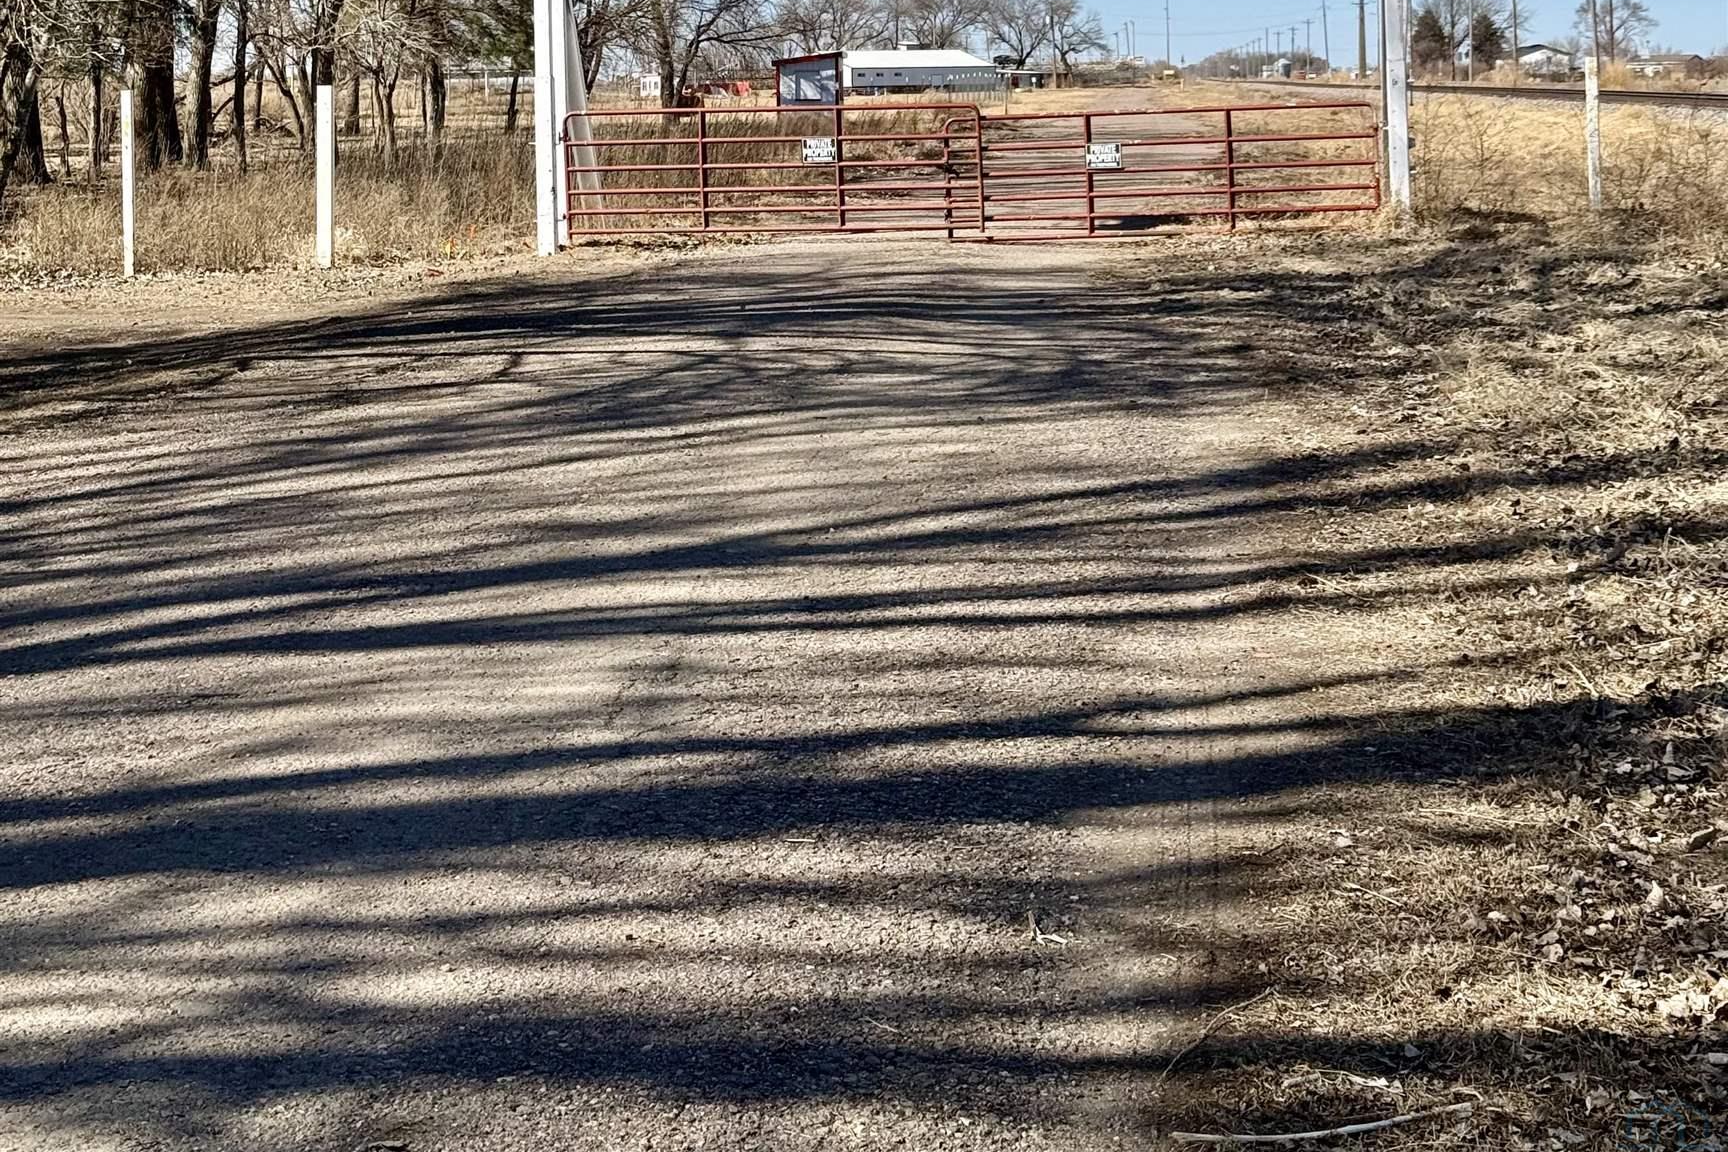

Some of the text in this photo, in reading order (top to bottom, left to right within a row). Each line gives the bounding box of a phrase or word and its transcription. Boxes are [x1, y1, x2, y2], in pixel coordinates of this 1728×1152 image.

[807, 138, 832, 149] PRIVATE
[803, 147, 836, 158] PROPERTY
[1090, 144, 1117, 155] PRIVATE
[1087, 153, 1120, 163] PROPERTY
